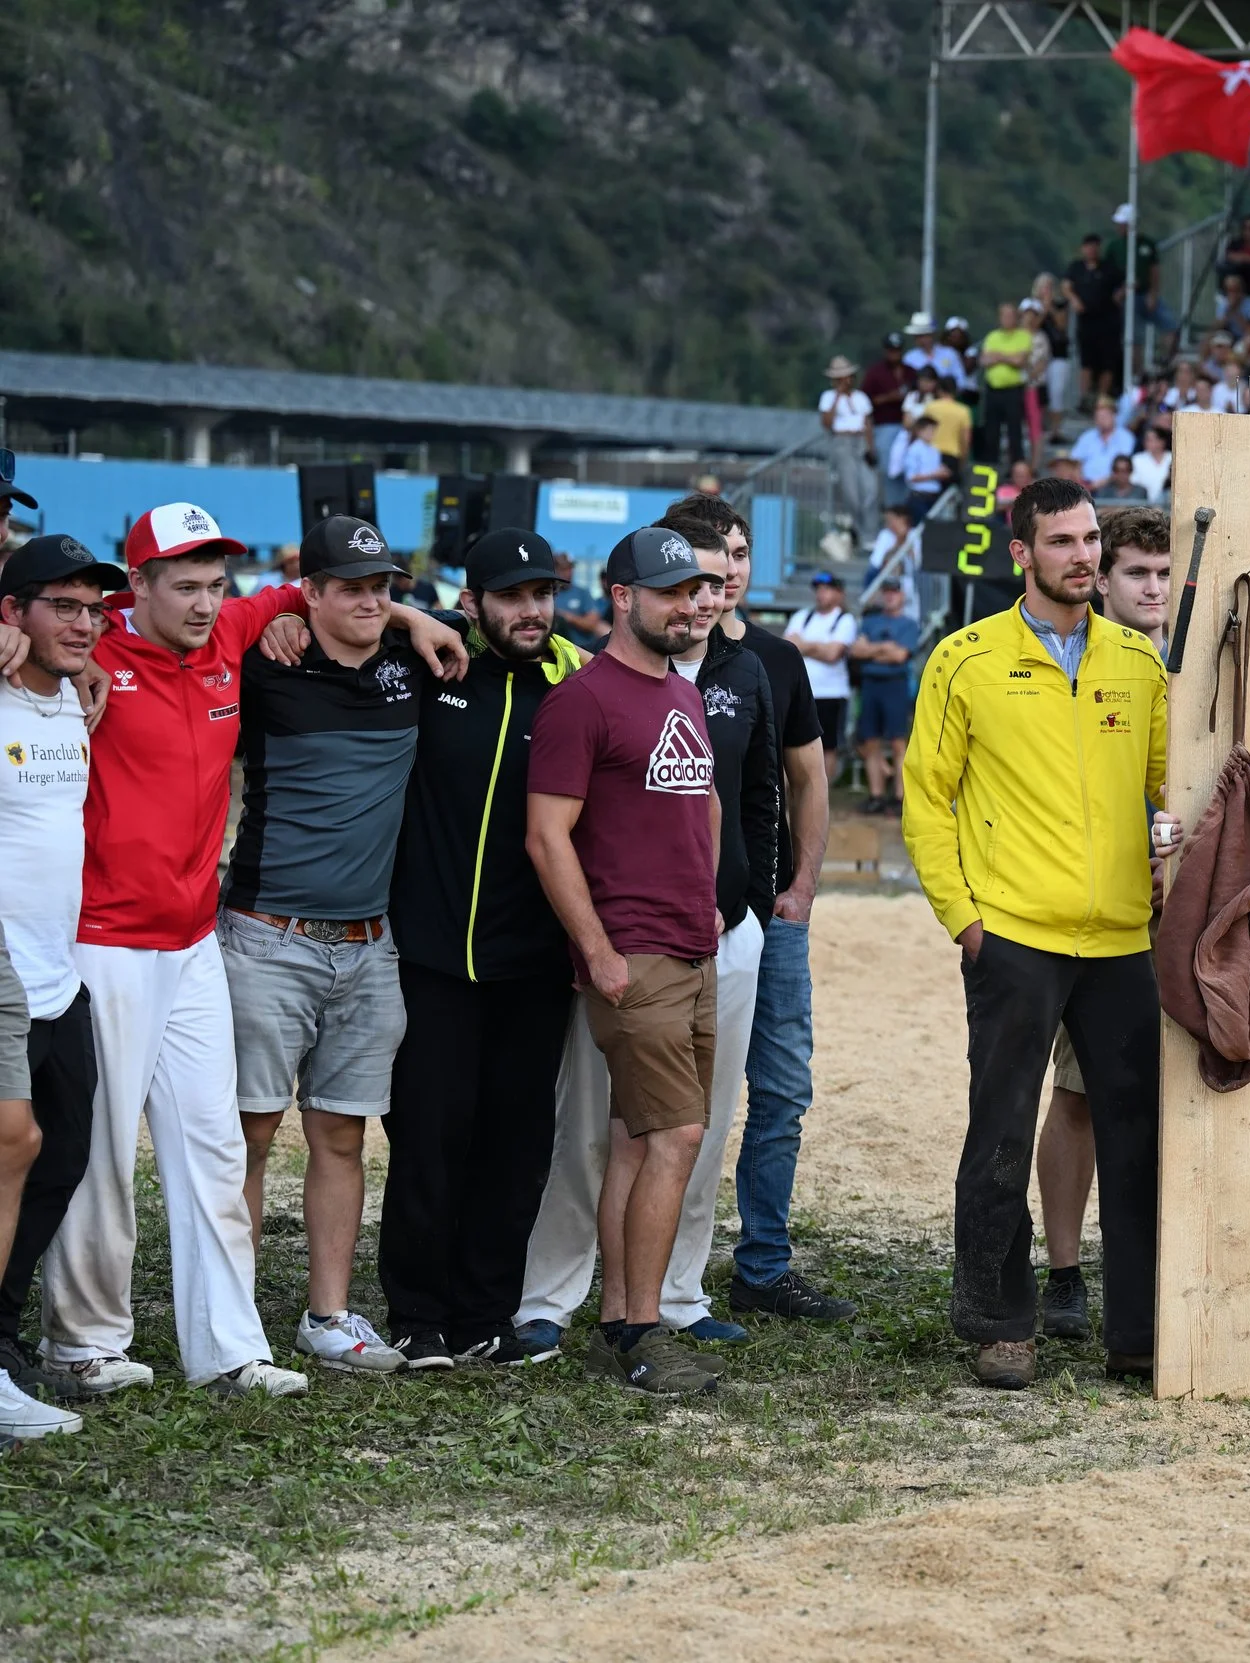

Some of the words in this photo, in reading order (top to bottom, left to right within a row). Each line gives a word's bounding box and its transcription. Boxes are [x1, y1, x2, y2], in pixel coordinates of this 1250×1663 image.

[967, 464, 998, 517] 3
[957, 523, 992, 576] 2
[1009, 670, 1032, 678] JAKO
[112, 684, 138, 692] hummel
[437, 692, 468, 709] JAKO
[30, 743, 80, 760] Fanclub
[18, 770, 55, 787] Herger
[657, 758, 711, 783] adidas
[631, 1365, 647, 1382] FILA
